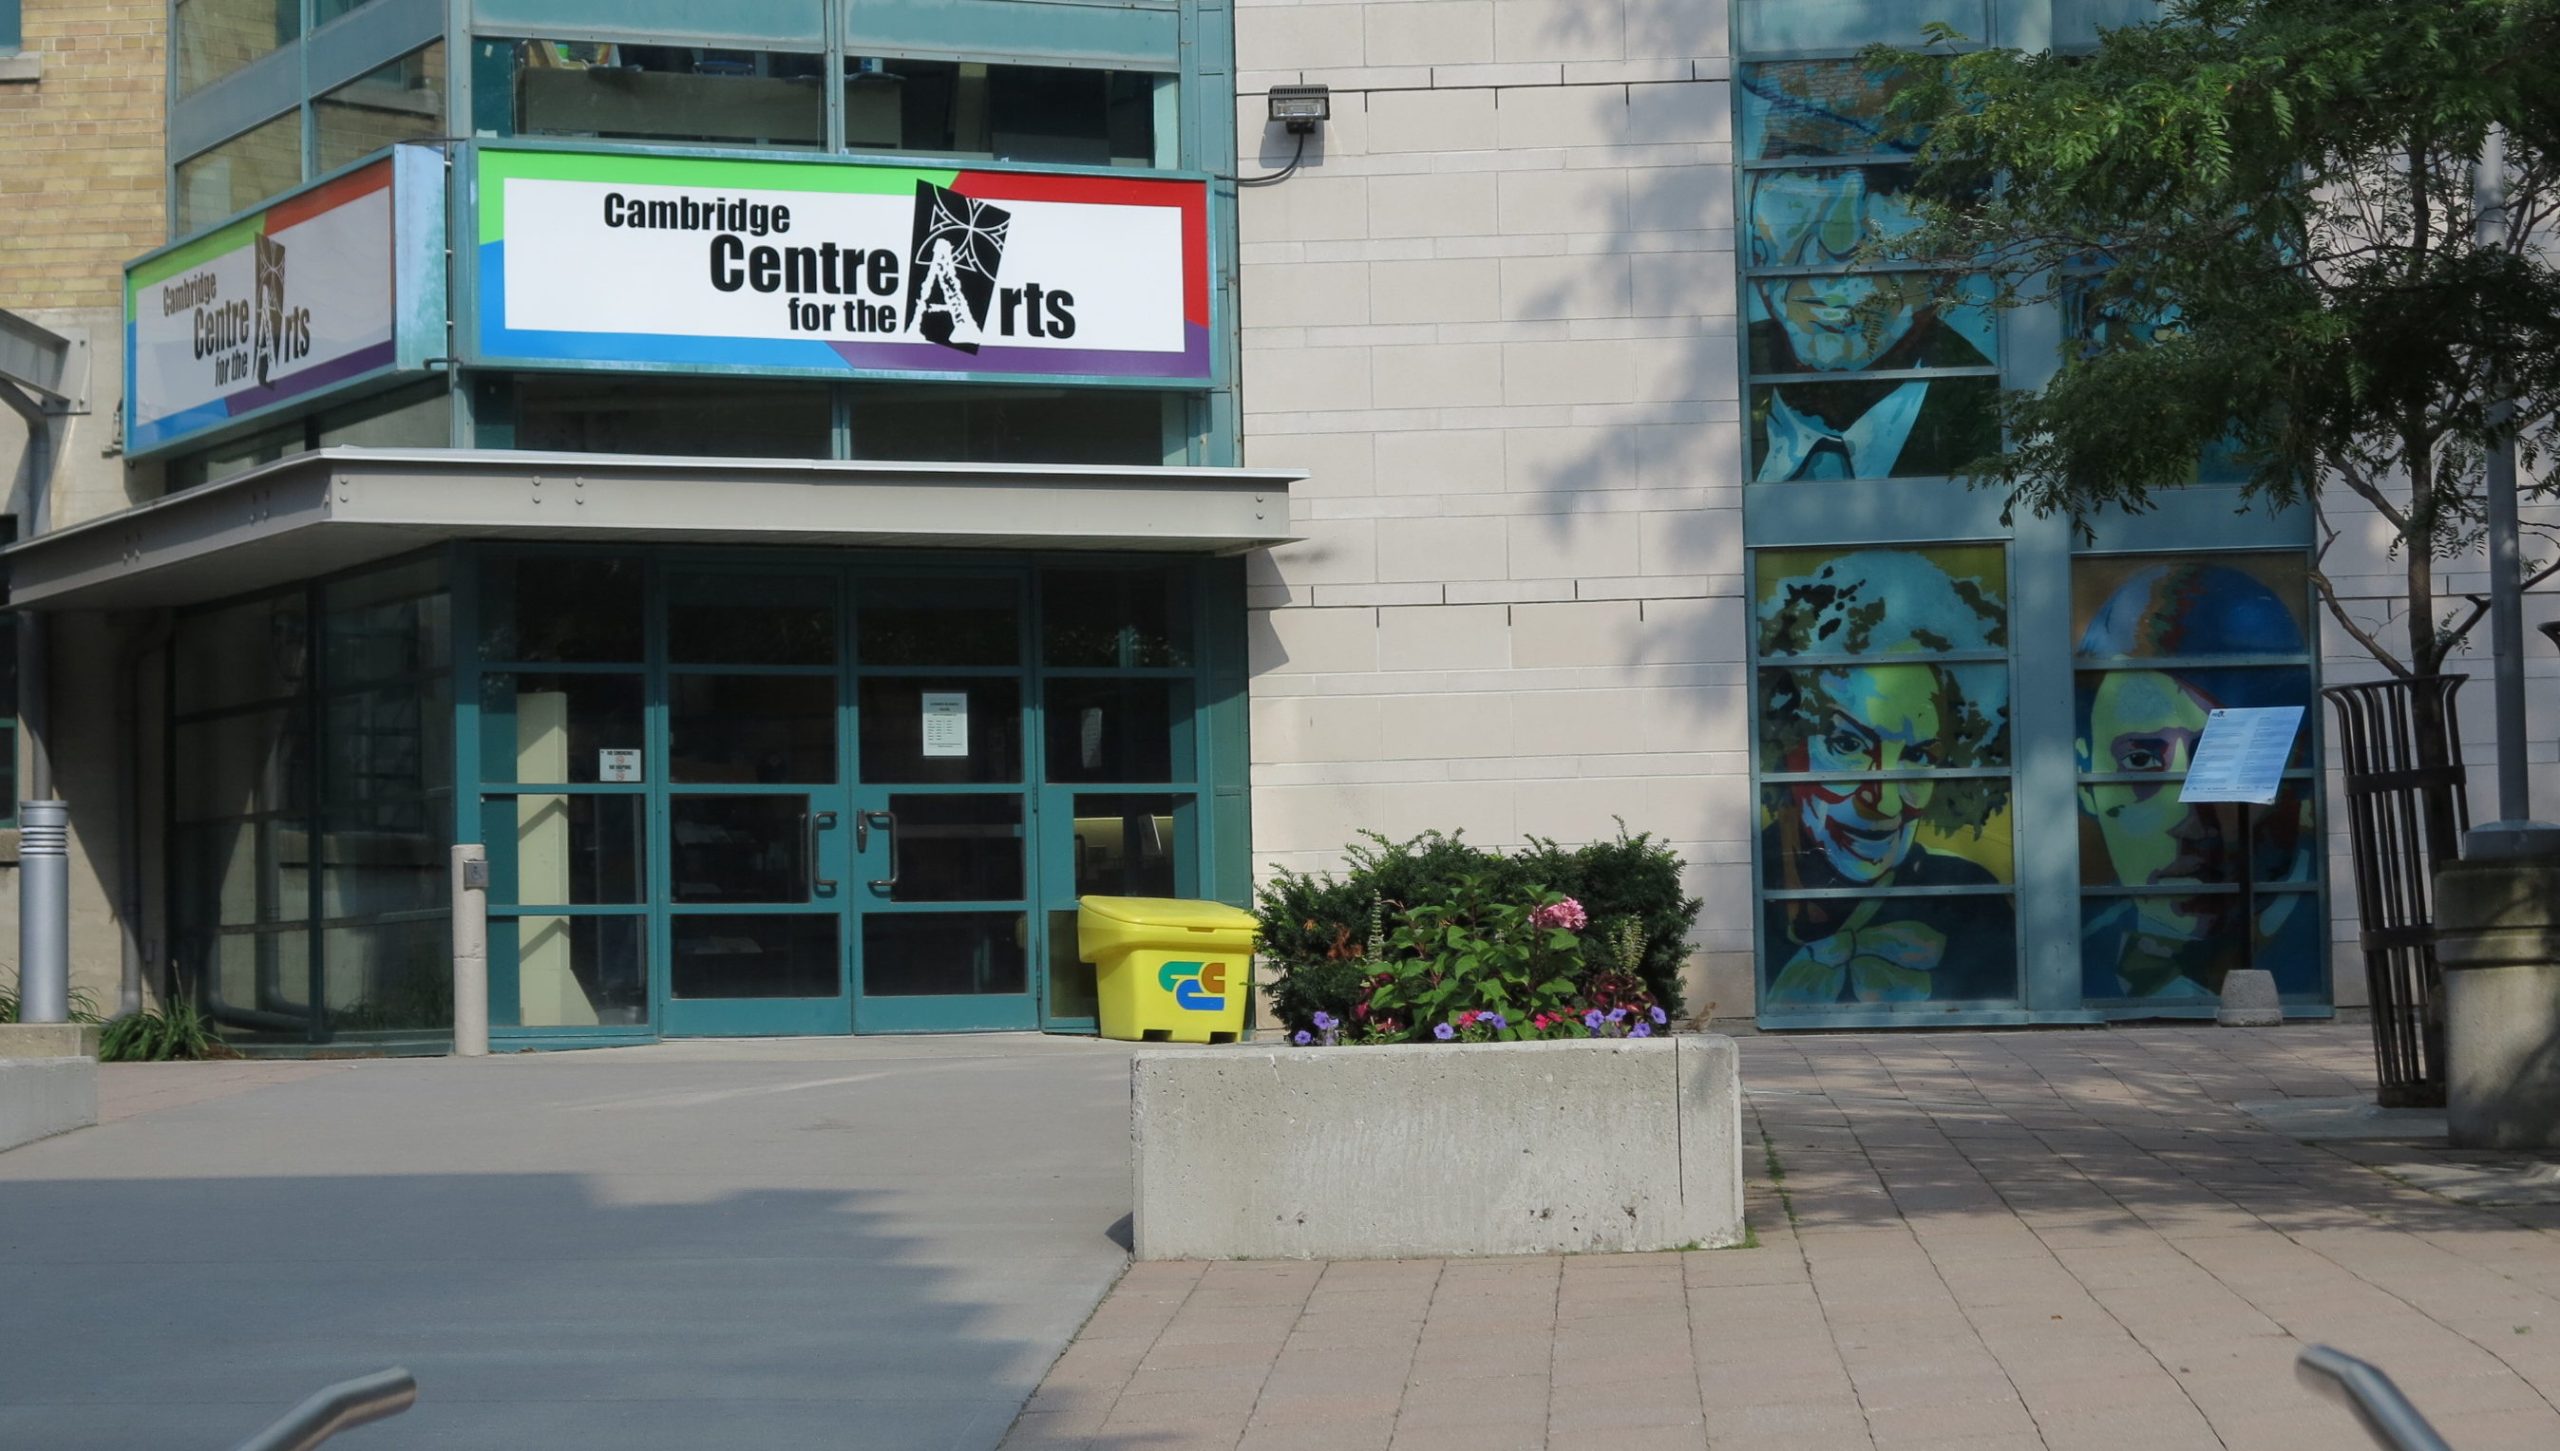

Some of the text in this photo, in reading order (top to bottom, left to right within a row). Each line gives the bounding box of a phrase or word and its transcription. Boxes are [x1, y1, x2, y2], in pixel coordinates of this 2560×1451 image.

[603, 191, 792, 236] Cambridge
[709, 233, 899, 297] Centre
[163, 272, 217, 317] Cambridge
[788, 297, 836, 332] for
[842, 299, 897, 334] the
[193, 298, 249, 361] Centre
[215, 355, 230, 387] for
[231, 349, 248, 381] the
